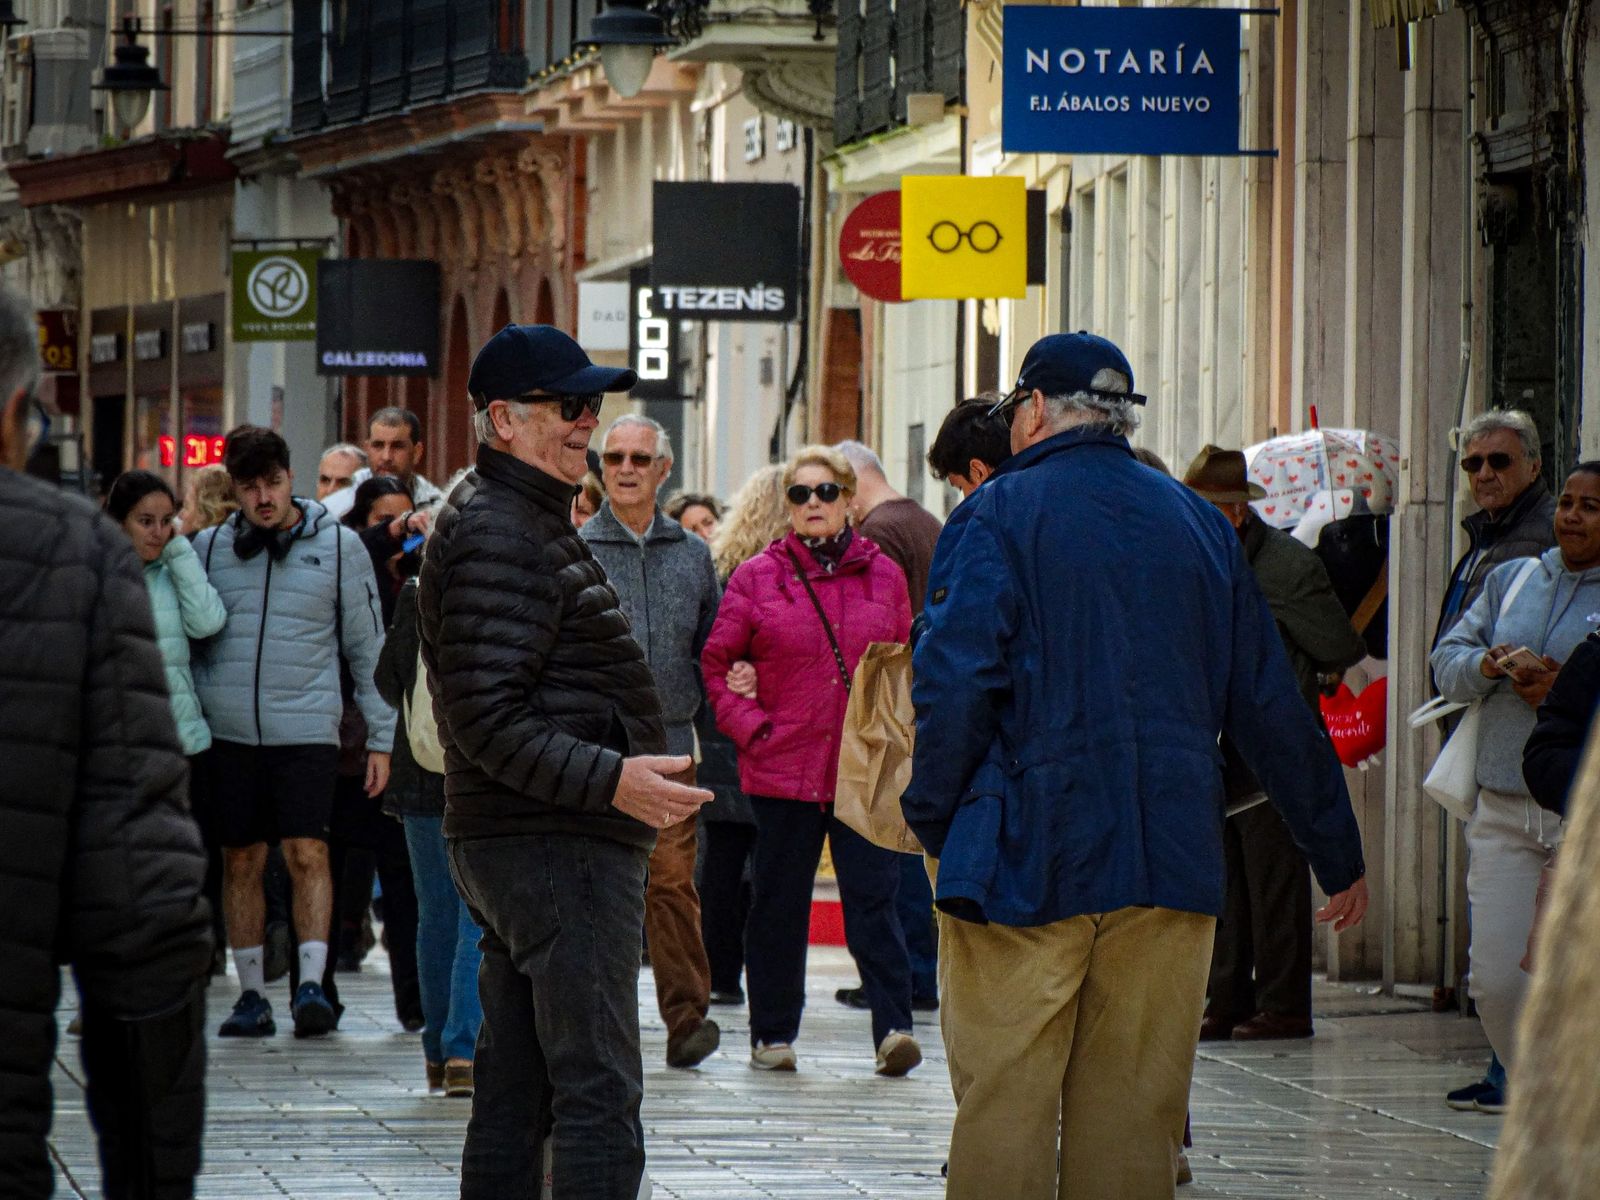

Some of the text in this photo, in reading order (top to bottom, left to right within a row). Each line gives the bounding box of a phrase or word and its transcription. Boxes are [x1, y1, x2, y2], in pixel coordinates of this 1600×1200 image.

[1026, 42, 1214, 74] NOTARÍA
[1057, 91, 1130, 112] ÁBALOS
[1142, 96, 1210, 112] NUEVO
[323, 351, 427, 367] CALZEDONIA
